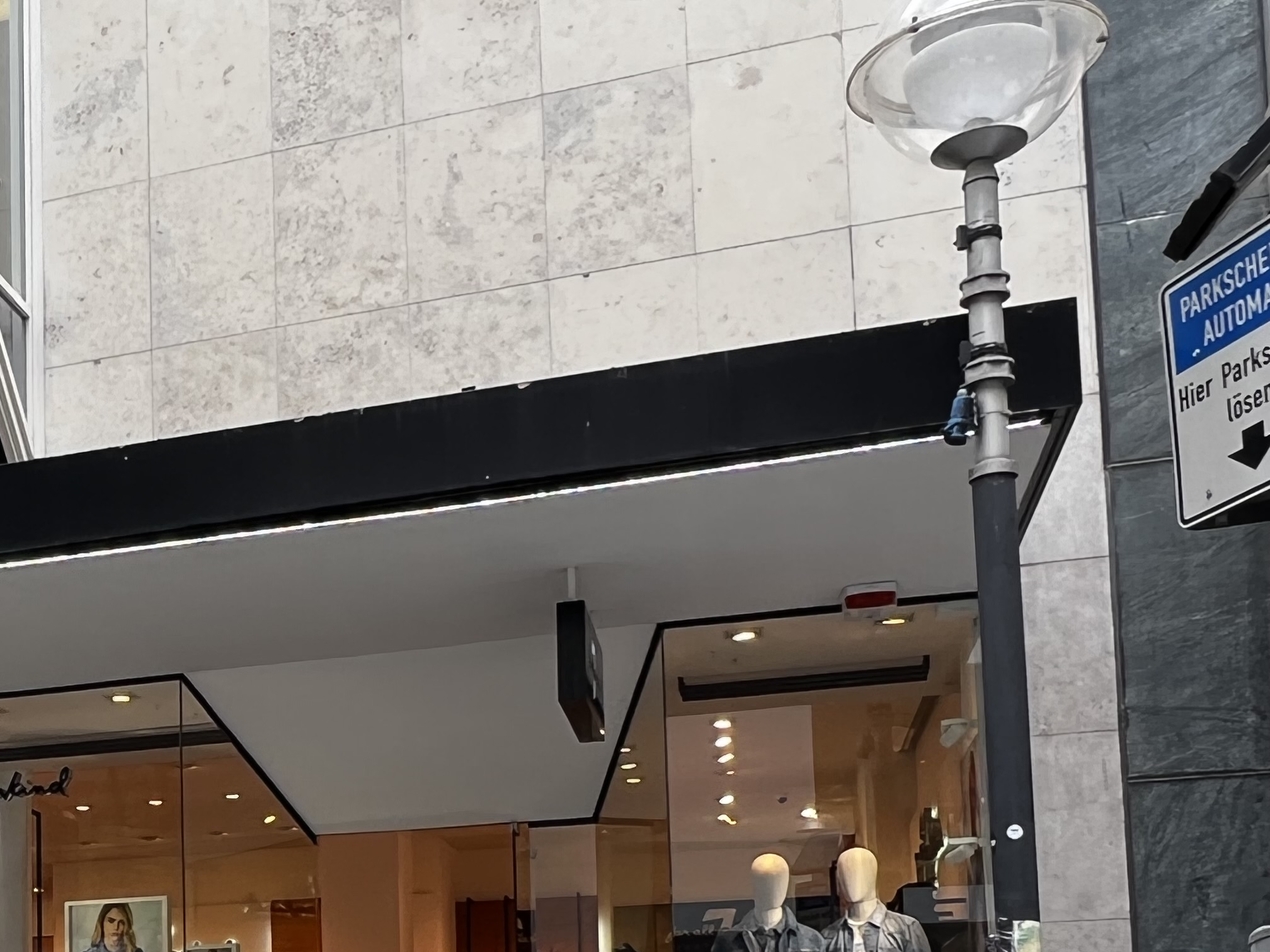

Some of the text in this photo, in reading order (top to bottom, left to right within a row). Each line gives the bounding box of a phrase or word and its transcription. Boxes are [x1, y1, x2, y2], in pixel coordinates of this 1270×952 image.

[1180, 242, 1270, 323] PARKSCHE
[1179, 345, 1270, 412] Hier Parks
